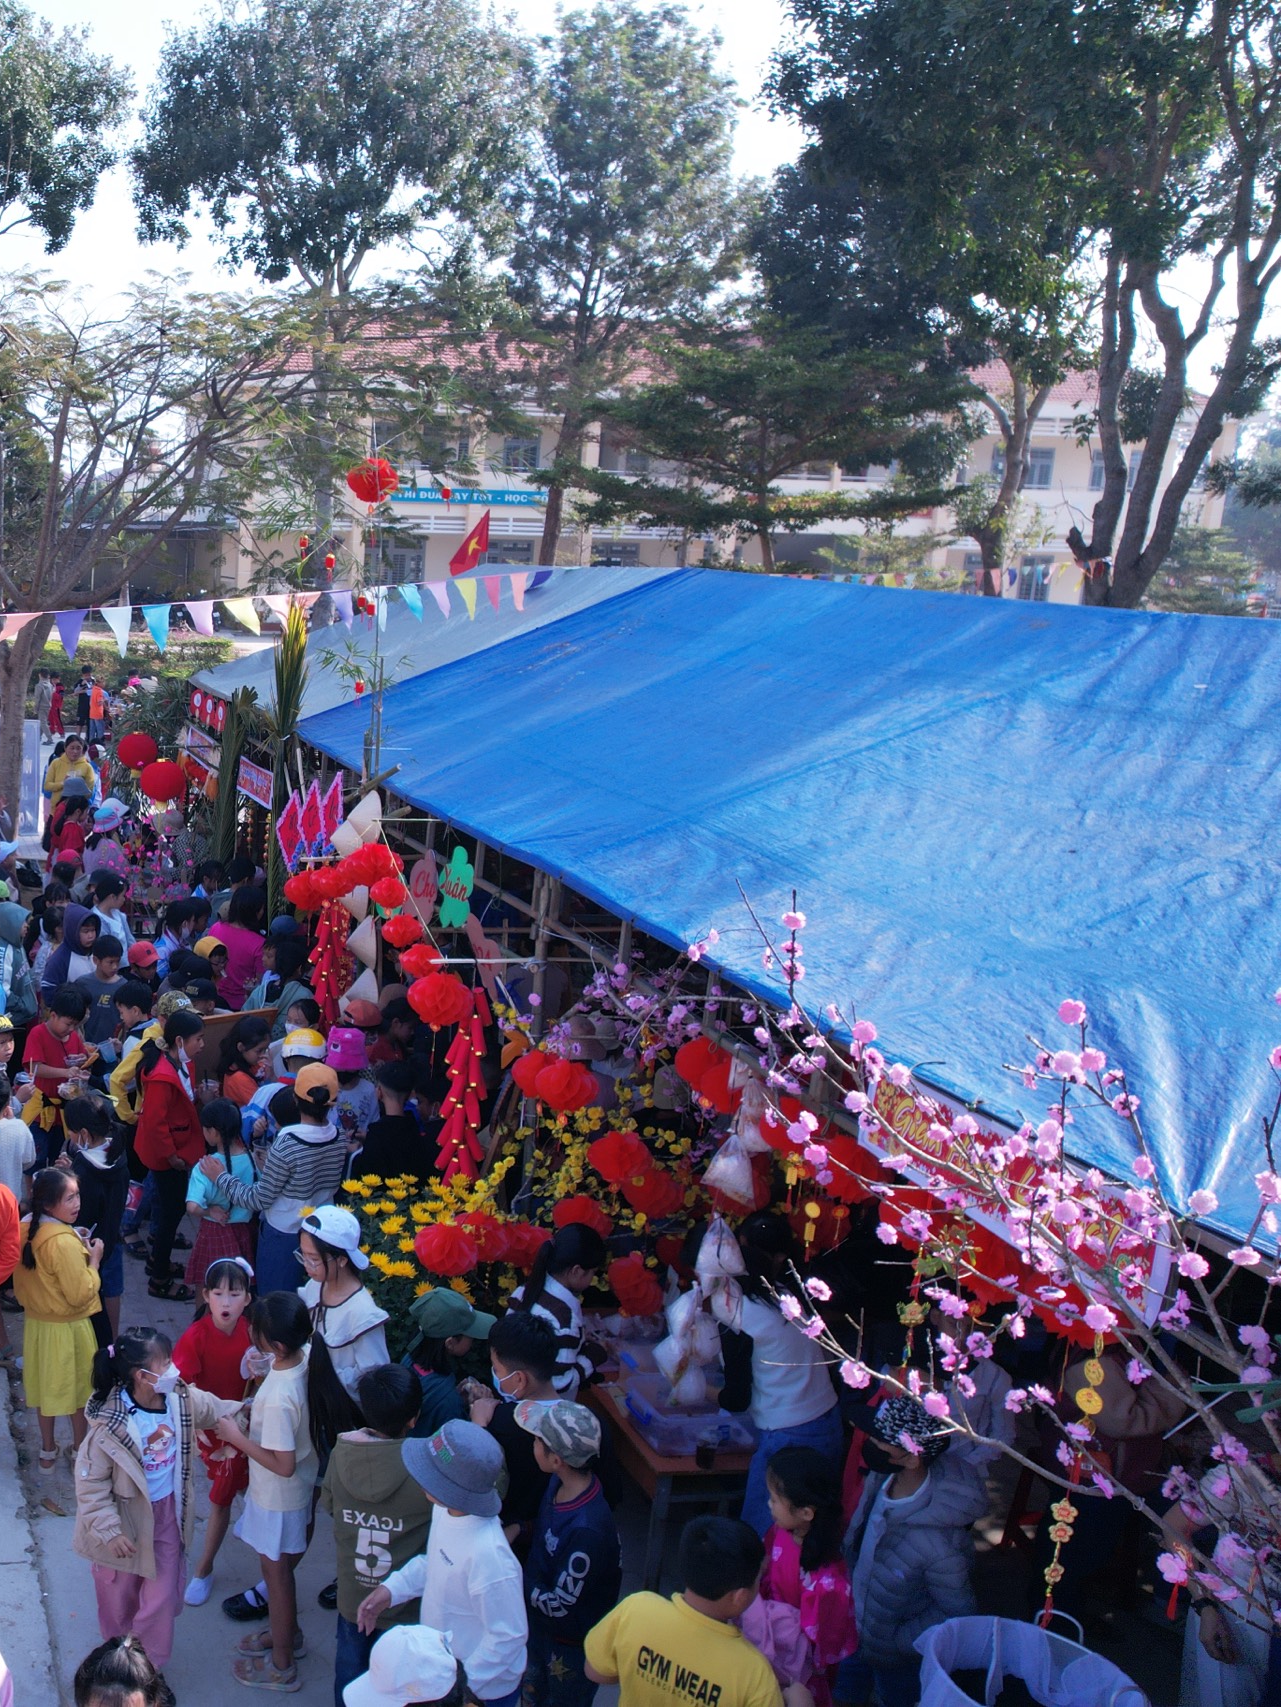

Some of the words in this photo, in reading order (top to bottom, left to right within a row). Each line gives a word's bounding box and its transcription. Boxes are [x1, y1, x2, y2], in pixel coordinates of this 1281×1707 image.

[354, 1528, 393, 1578] 5
[638, 1645, 672, 1682] GYM
[675, 1664, 722, 1707] WEAR
